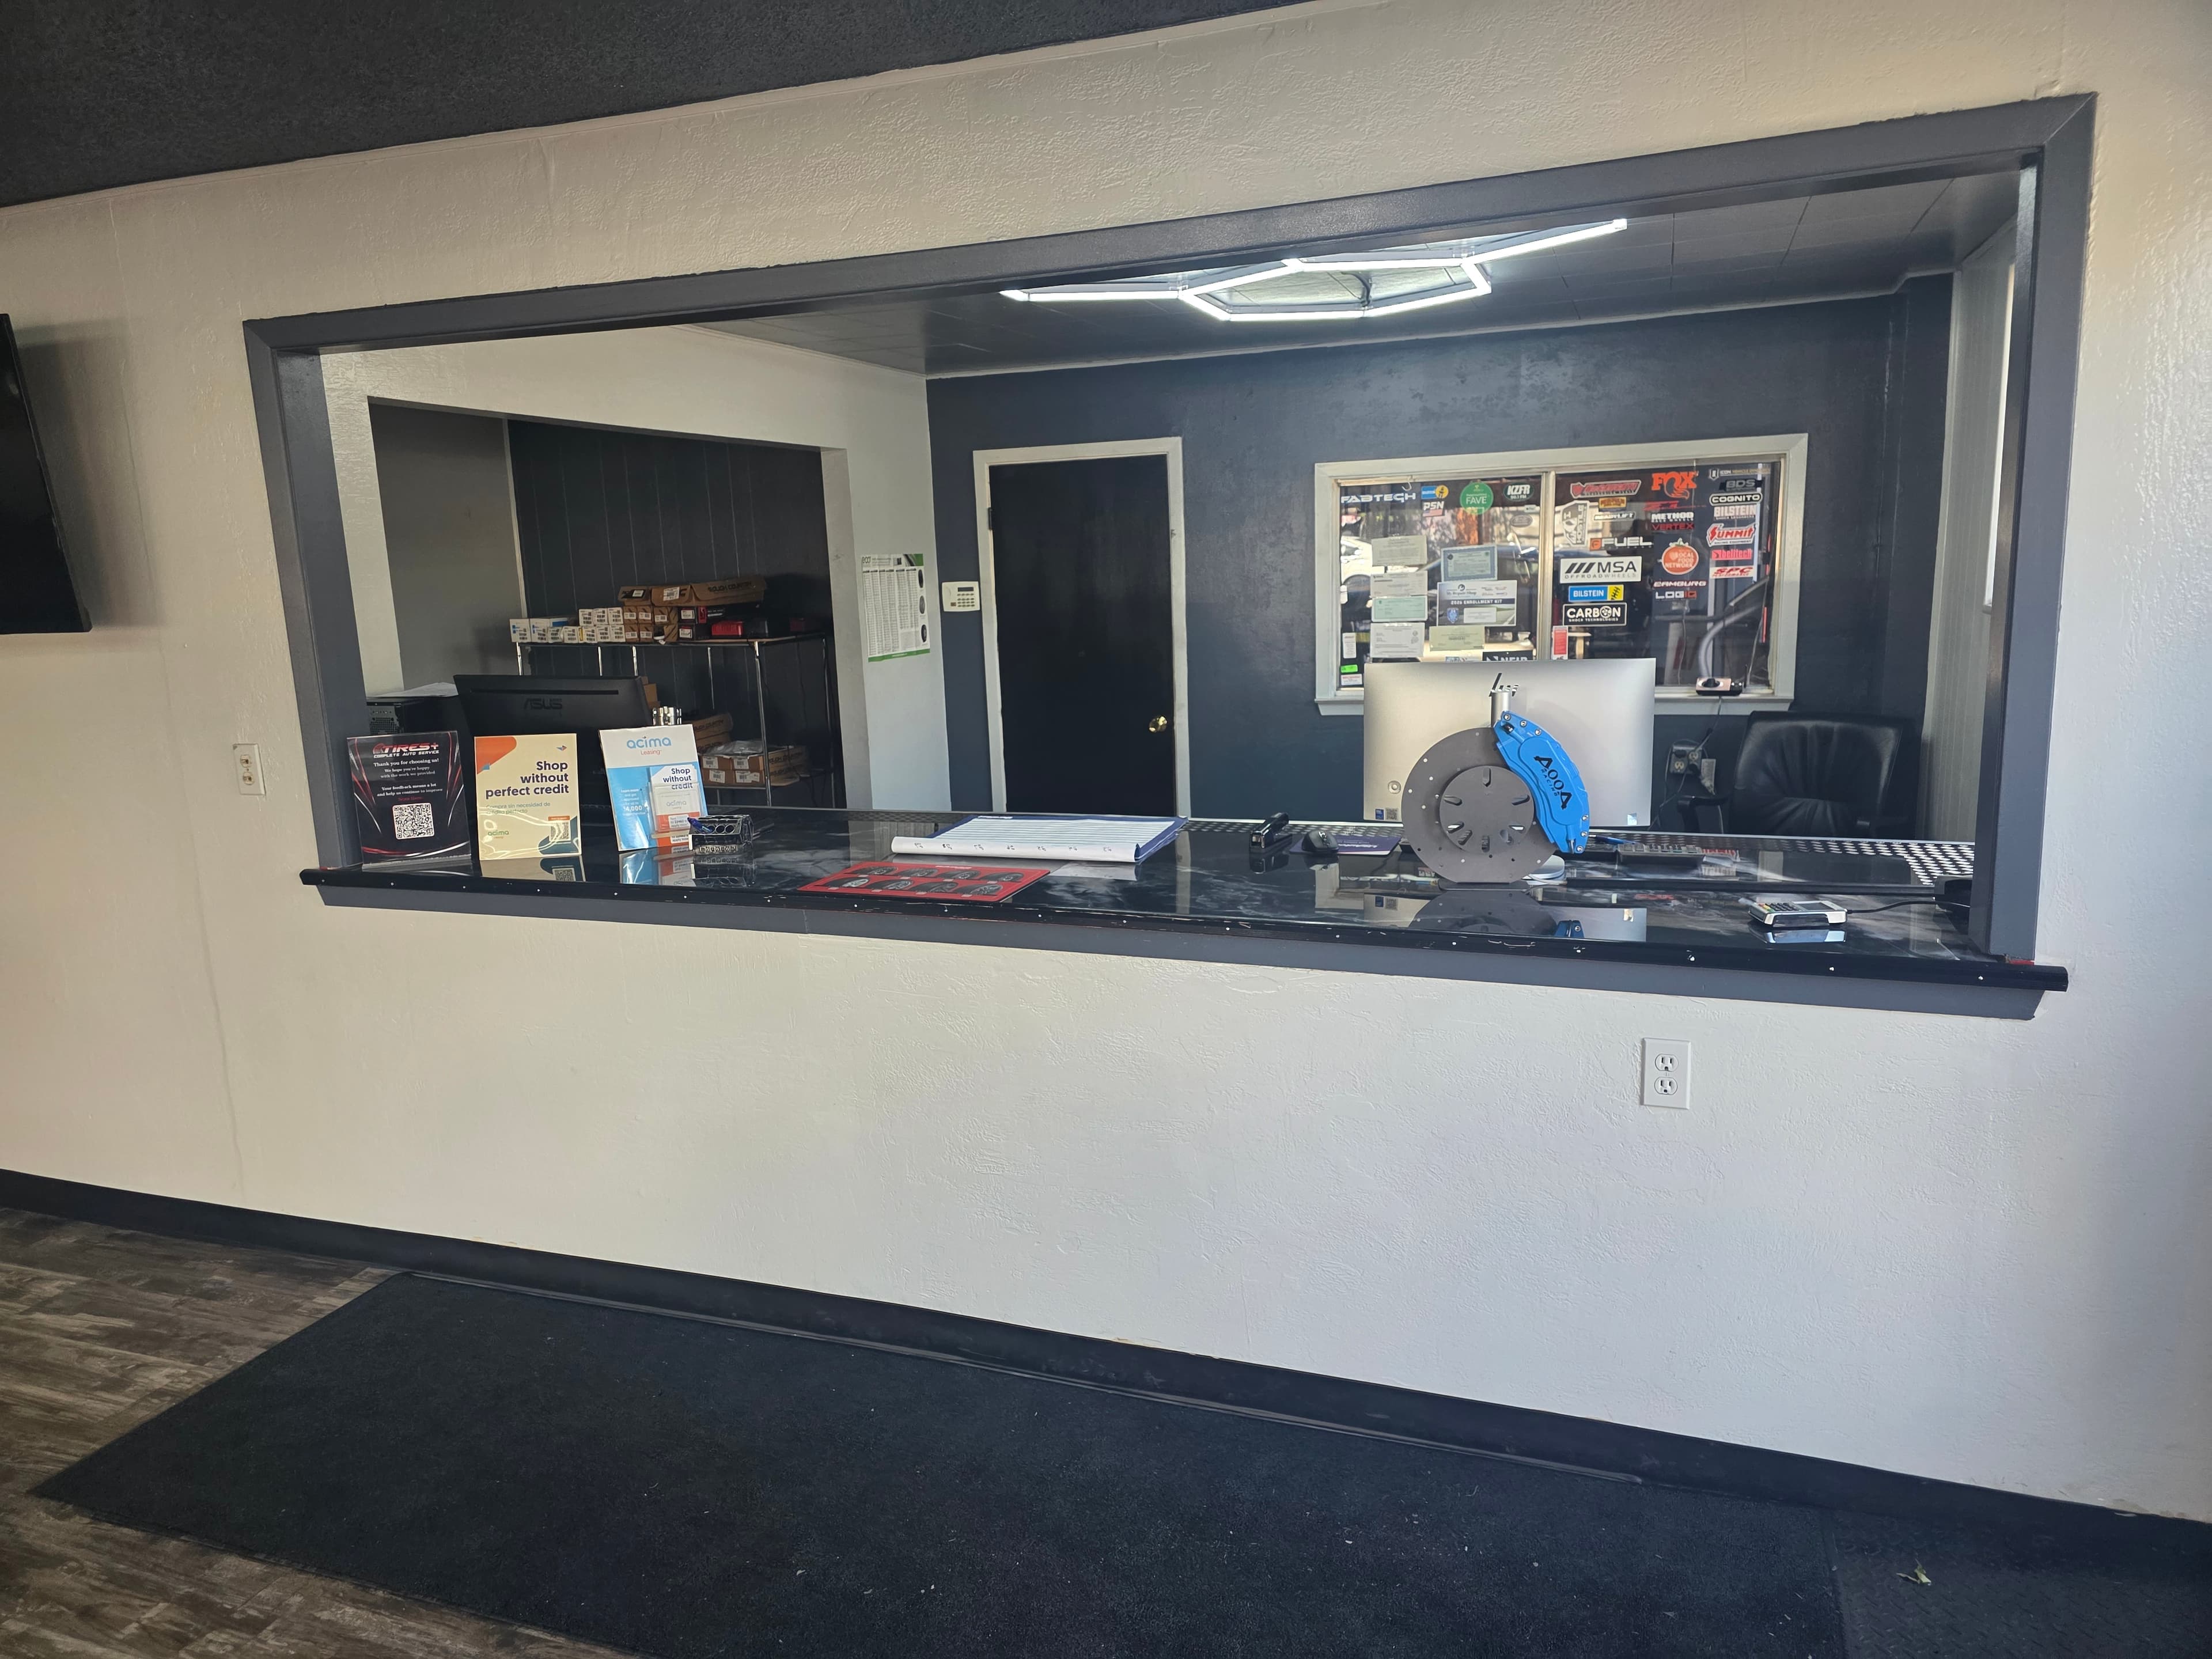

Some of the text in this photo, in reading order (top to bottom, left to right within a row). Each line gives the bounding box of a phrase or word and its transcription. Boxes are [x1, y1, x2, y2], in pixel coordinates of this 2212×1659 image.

[1652, 471, 1697, 490] FOX
[1726, 479, 1755, 488] BDS
[1507, 484, 1531, 495] KZFR
[1340, 493, 1416, 503] FABTECH
[1465, 496, 1487, 504] FAVE
[1712, 494, 1760, 503] COGNITO
[1423, 501, 1445, 510] PSN
[1714, 504, 1756, 517] BILSTEIN
[1652, 512, 1694, 520] METHOD
[1602, 536, 1653, 547] FUEL
[1597, 561, 1637, 573] MSA
[1567, 605, 1621, 619] CARBON
[524, 698, 563, 710] ASUS
[627, 736, 672, 749] acima
[536, 761, 568, 772] Shop
[520, 773, 569, 783] without
[671, 768, 690, 777] Shop
[662, 775, 692, 783] without
[1541, 769, 1557, 796] RACING
[486, 784, 569, 800] perfect credit
